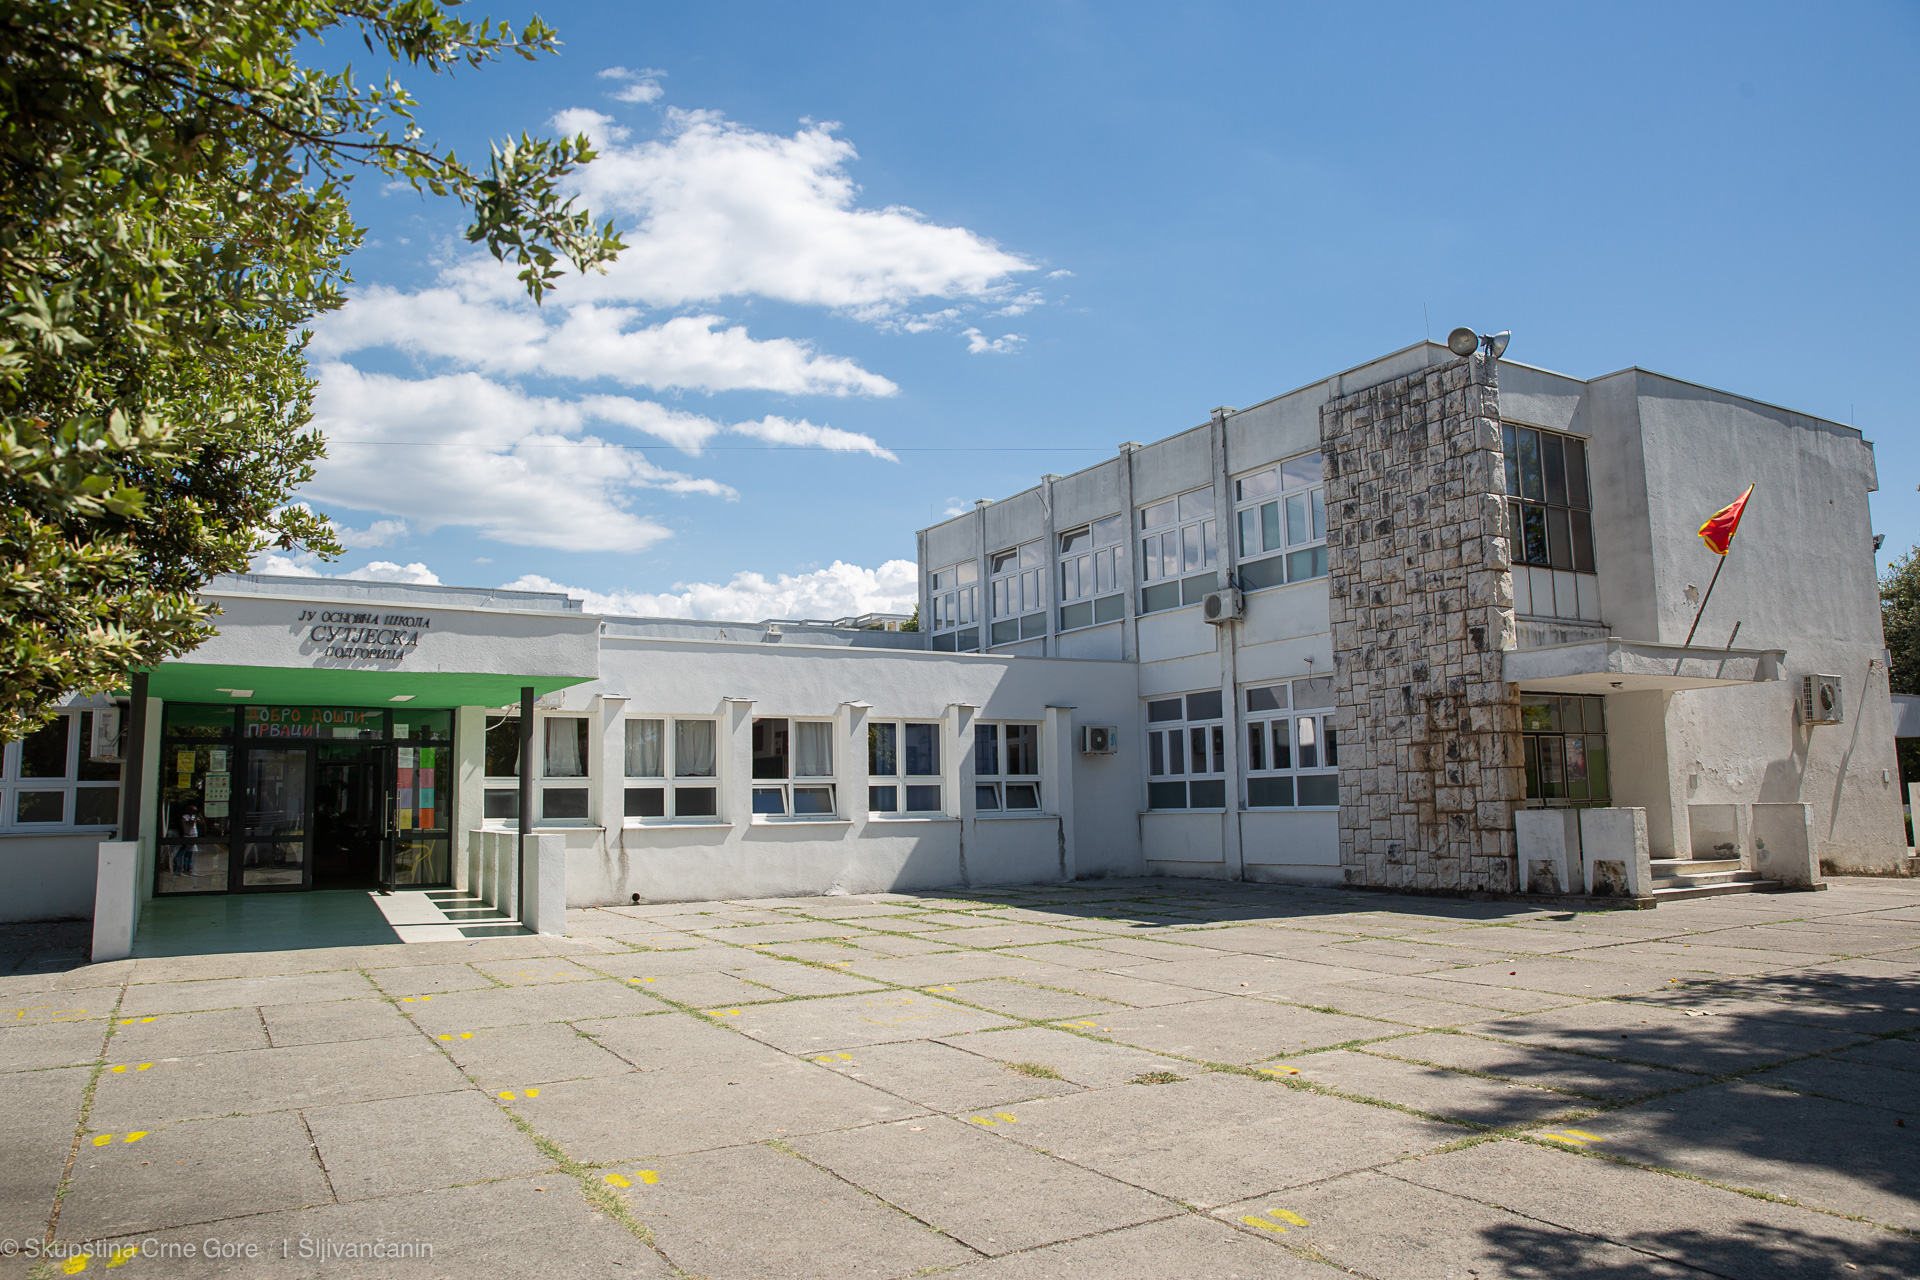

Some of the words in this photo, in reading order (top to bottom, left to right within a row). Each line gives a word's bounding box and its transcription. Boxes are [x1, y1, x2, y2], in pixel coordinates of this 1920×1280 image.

[298, 610, 317, 621] ЈУ
[321, 611, 379, 625] ОСНОВНА
[384, 615, 431, 628] ШКОЛА
[310, 625, 419, 646] СУТЈЕСКА
[324, 646, 405, 661] ПОДГОРИЦА
[248, 708, 301, 722] ДОБРО
[248, 723, 320, 738] ПРВАЦИ!
